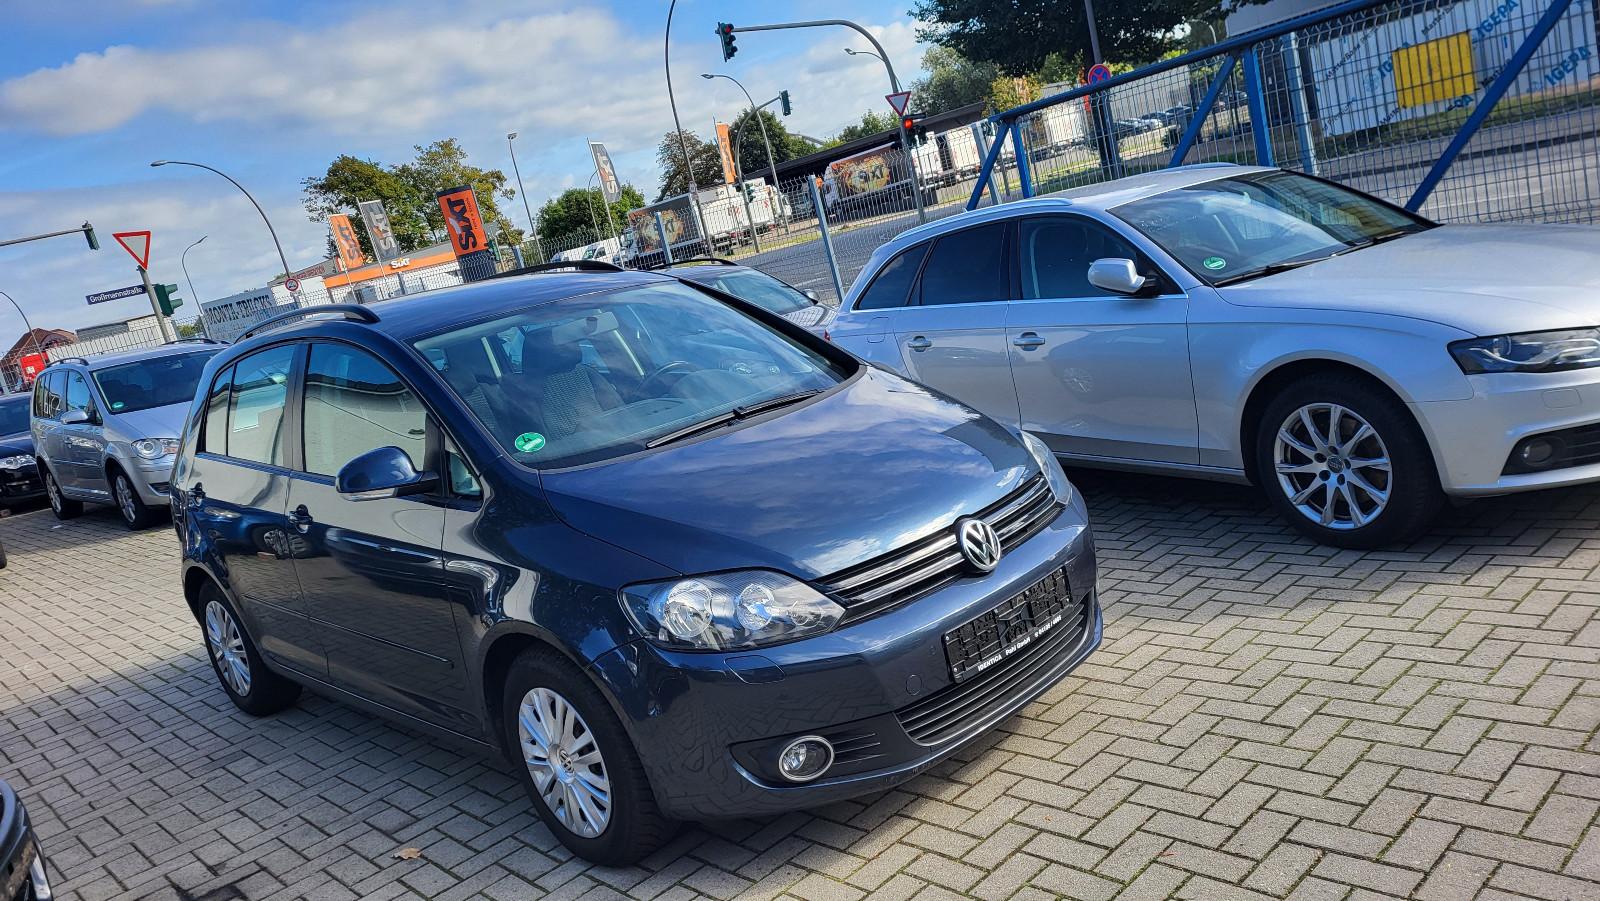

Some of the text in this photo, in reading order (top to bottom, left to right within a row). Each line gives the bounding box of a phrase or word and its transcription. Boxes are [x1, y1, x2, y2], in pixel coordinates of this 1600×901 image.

[1476, 0, 1518, 38] IGEPA
[1544, 46, 1591, 86] IGEPA
[89, 287, 143, 303] Großmannstraße
